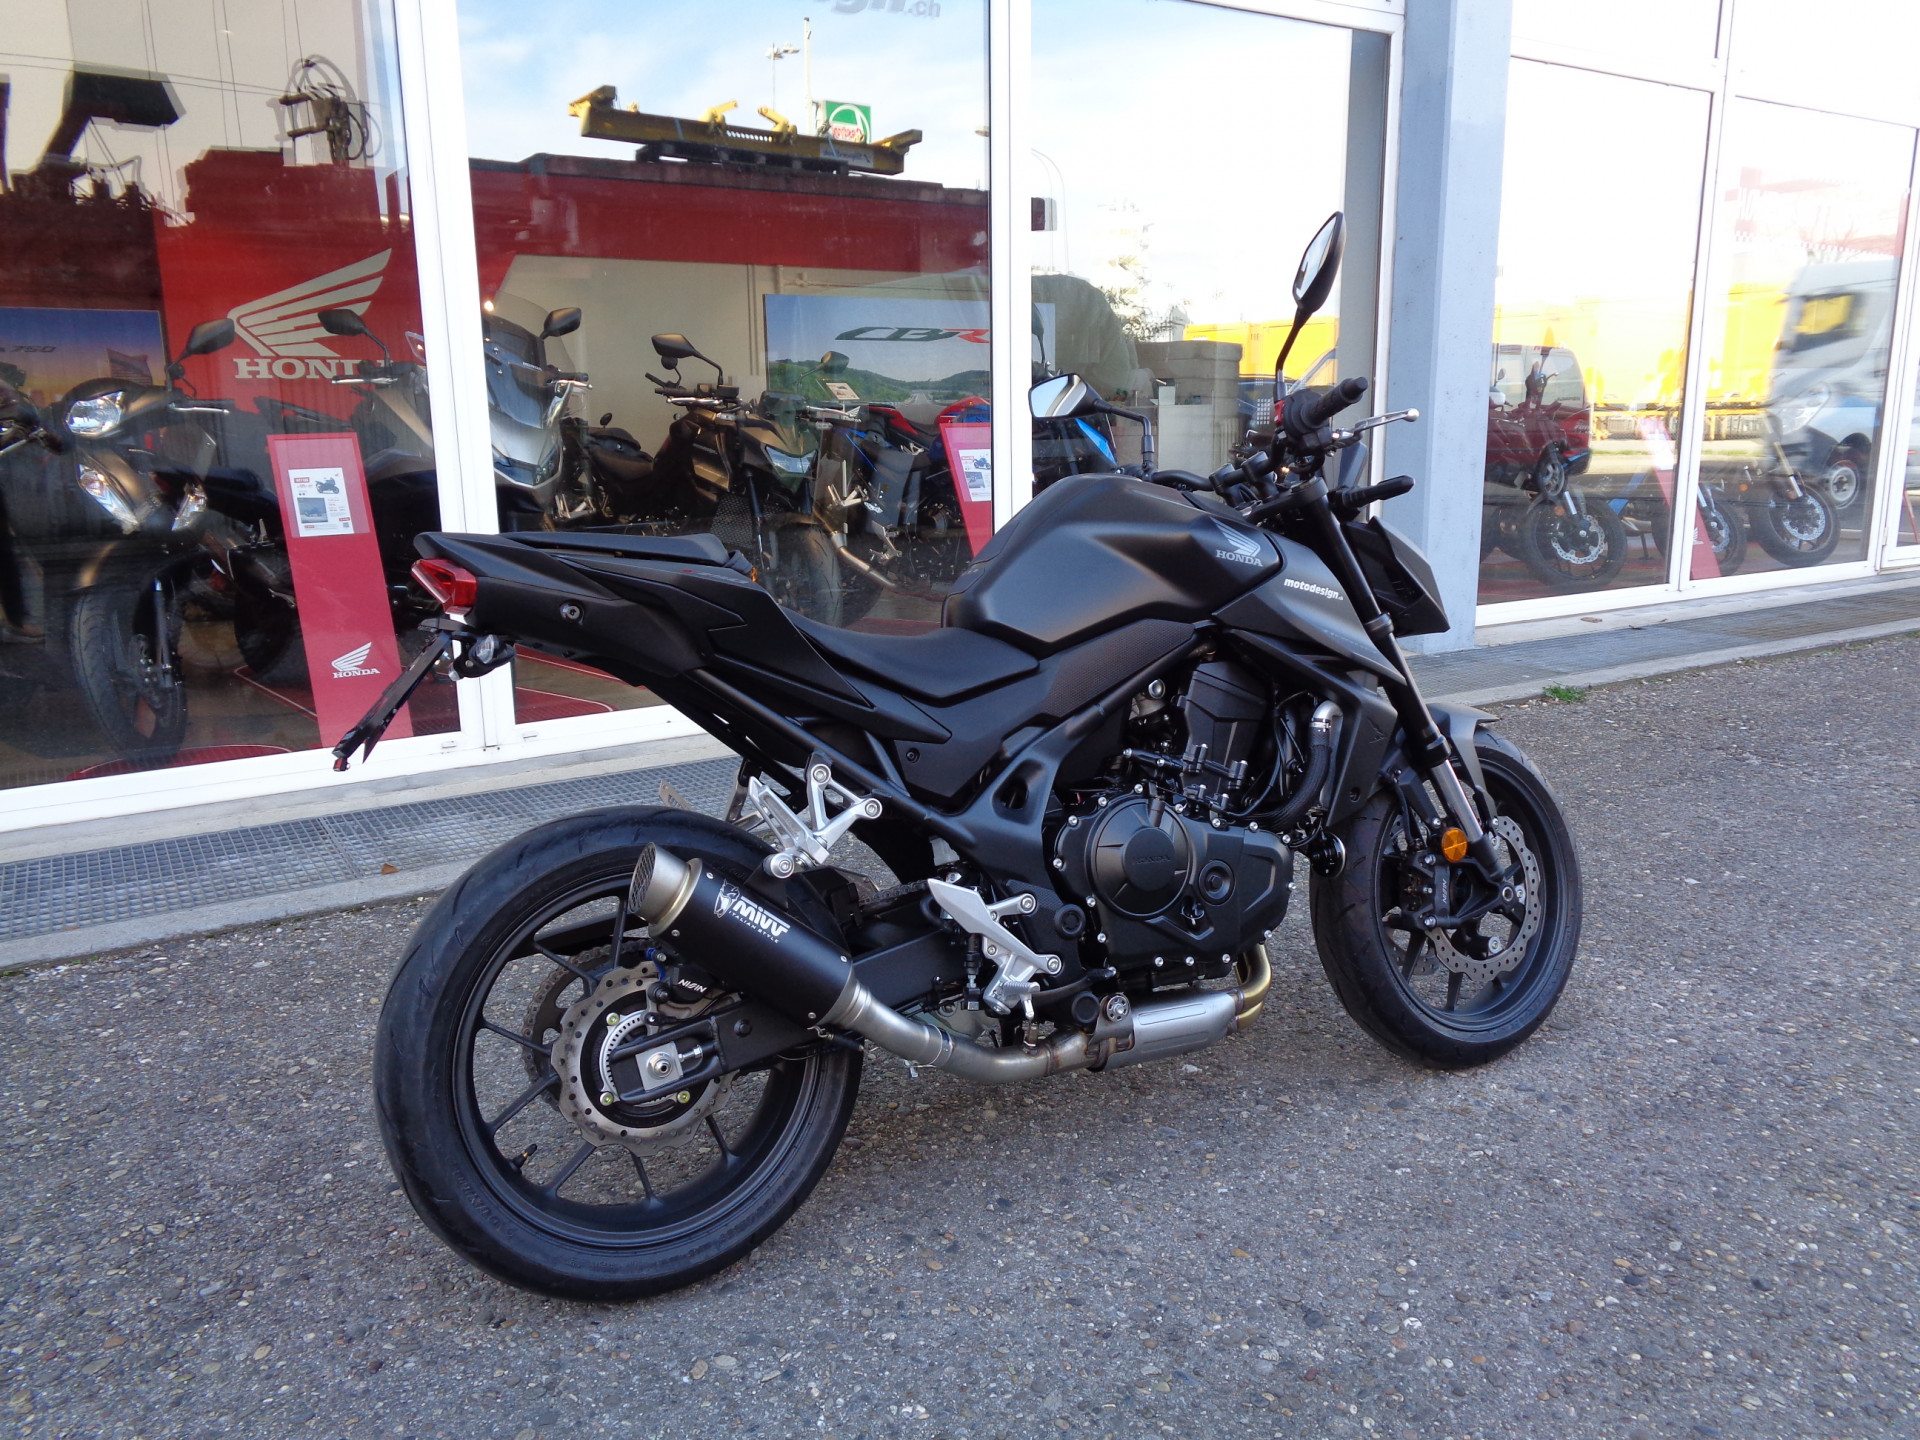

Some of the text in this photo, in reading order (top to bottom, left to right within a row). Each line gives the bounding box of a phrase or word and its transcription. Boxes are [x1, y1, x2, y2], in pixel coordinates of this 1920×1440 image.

[233, 358, 393, 379] HON
[1216, 549, 1263, 567] HONDA
[332, 667, 381, 679] HONDA
